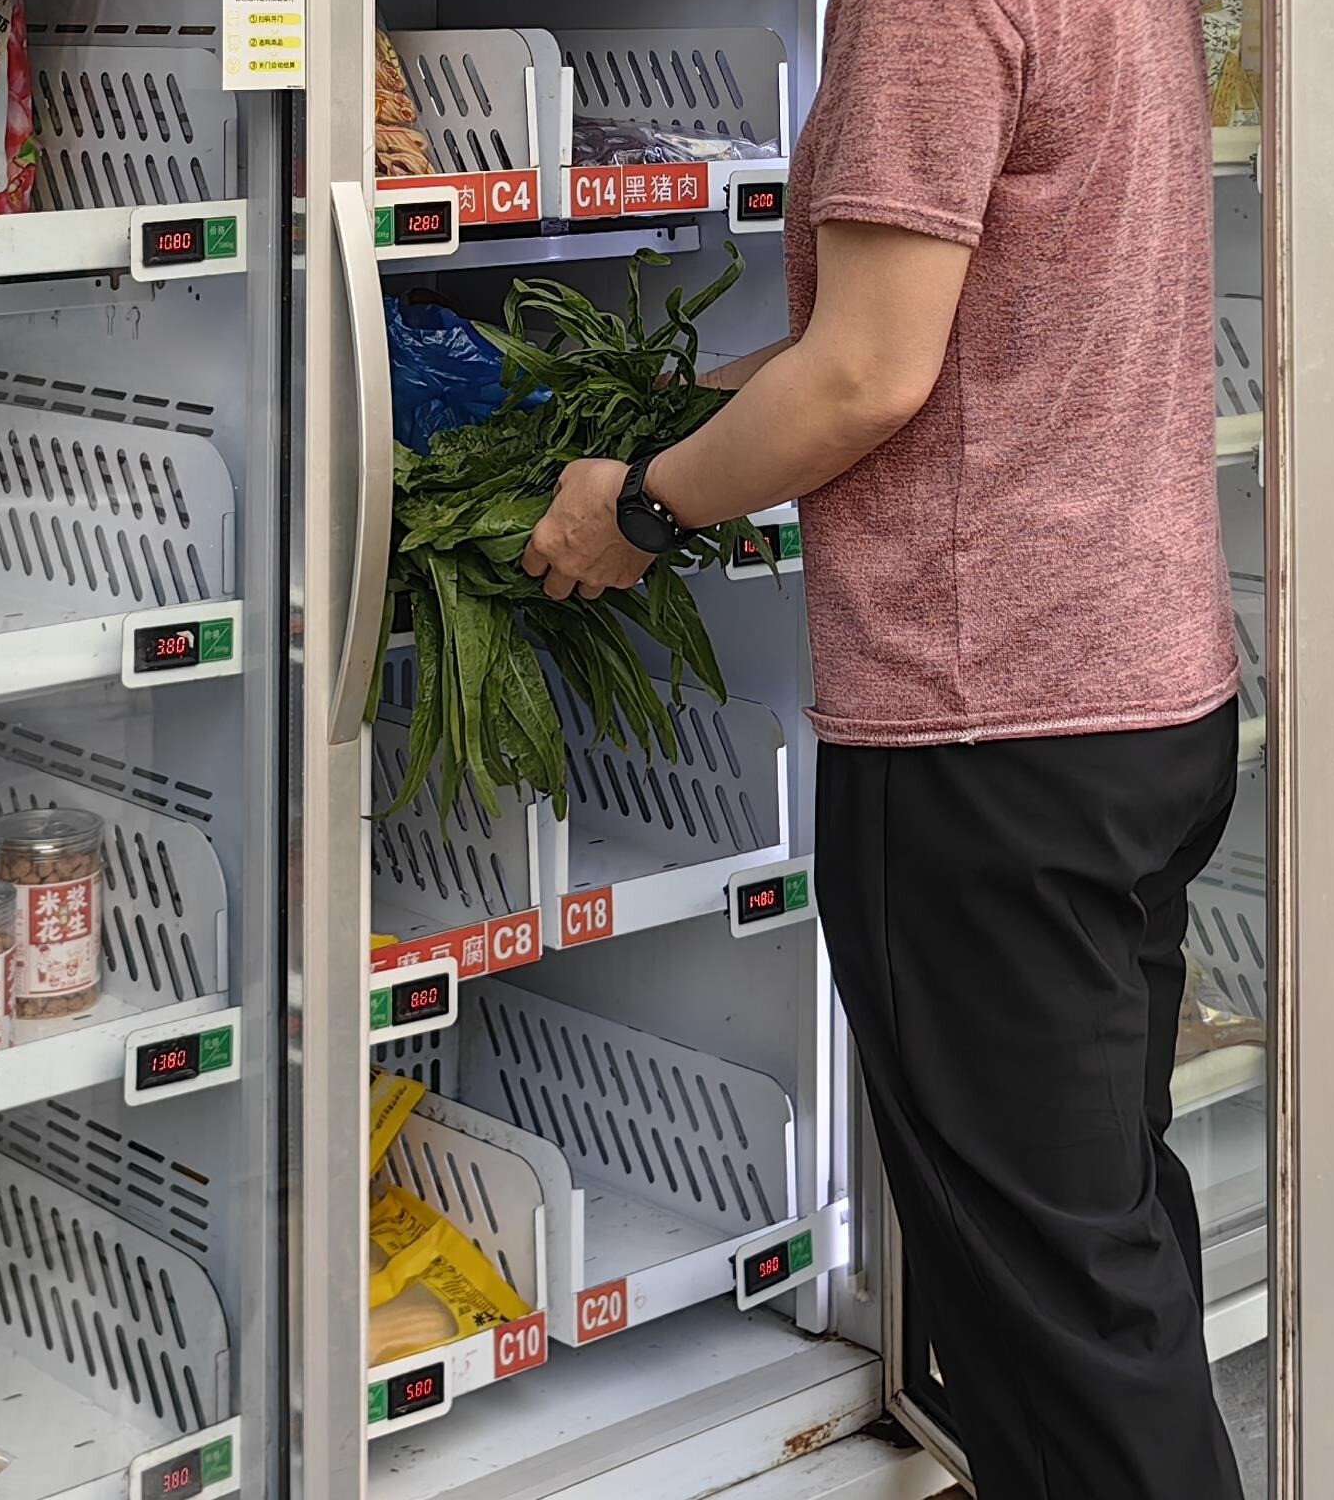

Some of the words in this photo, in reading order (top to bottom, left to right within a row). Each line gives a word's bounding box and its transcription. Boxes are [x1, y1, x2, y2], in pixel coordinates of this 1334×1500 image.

[491, 180, 531, 211] C4
[575, 176, 616, 206] C14
[623, 171, 699, 204] 黑猪肉
[566, 897, 608, 933] C18
[492, 925, 532, 962] C8
[581, 1294, 623, 1331] C20
[499, 1327, 540, 1366] C10
